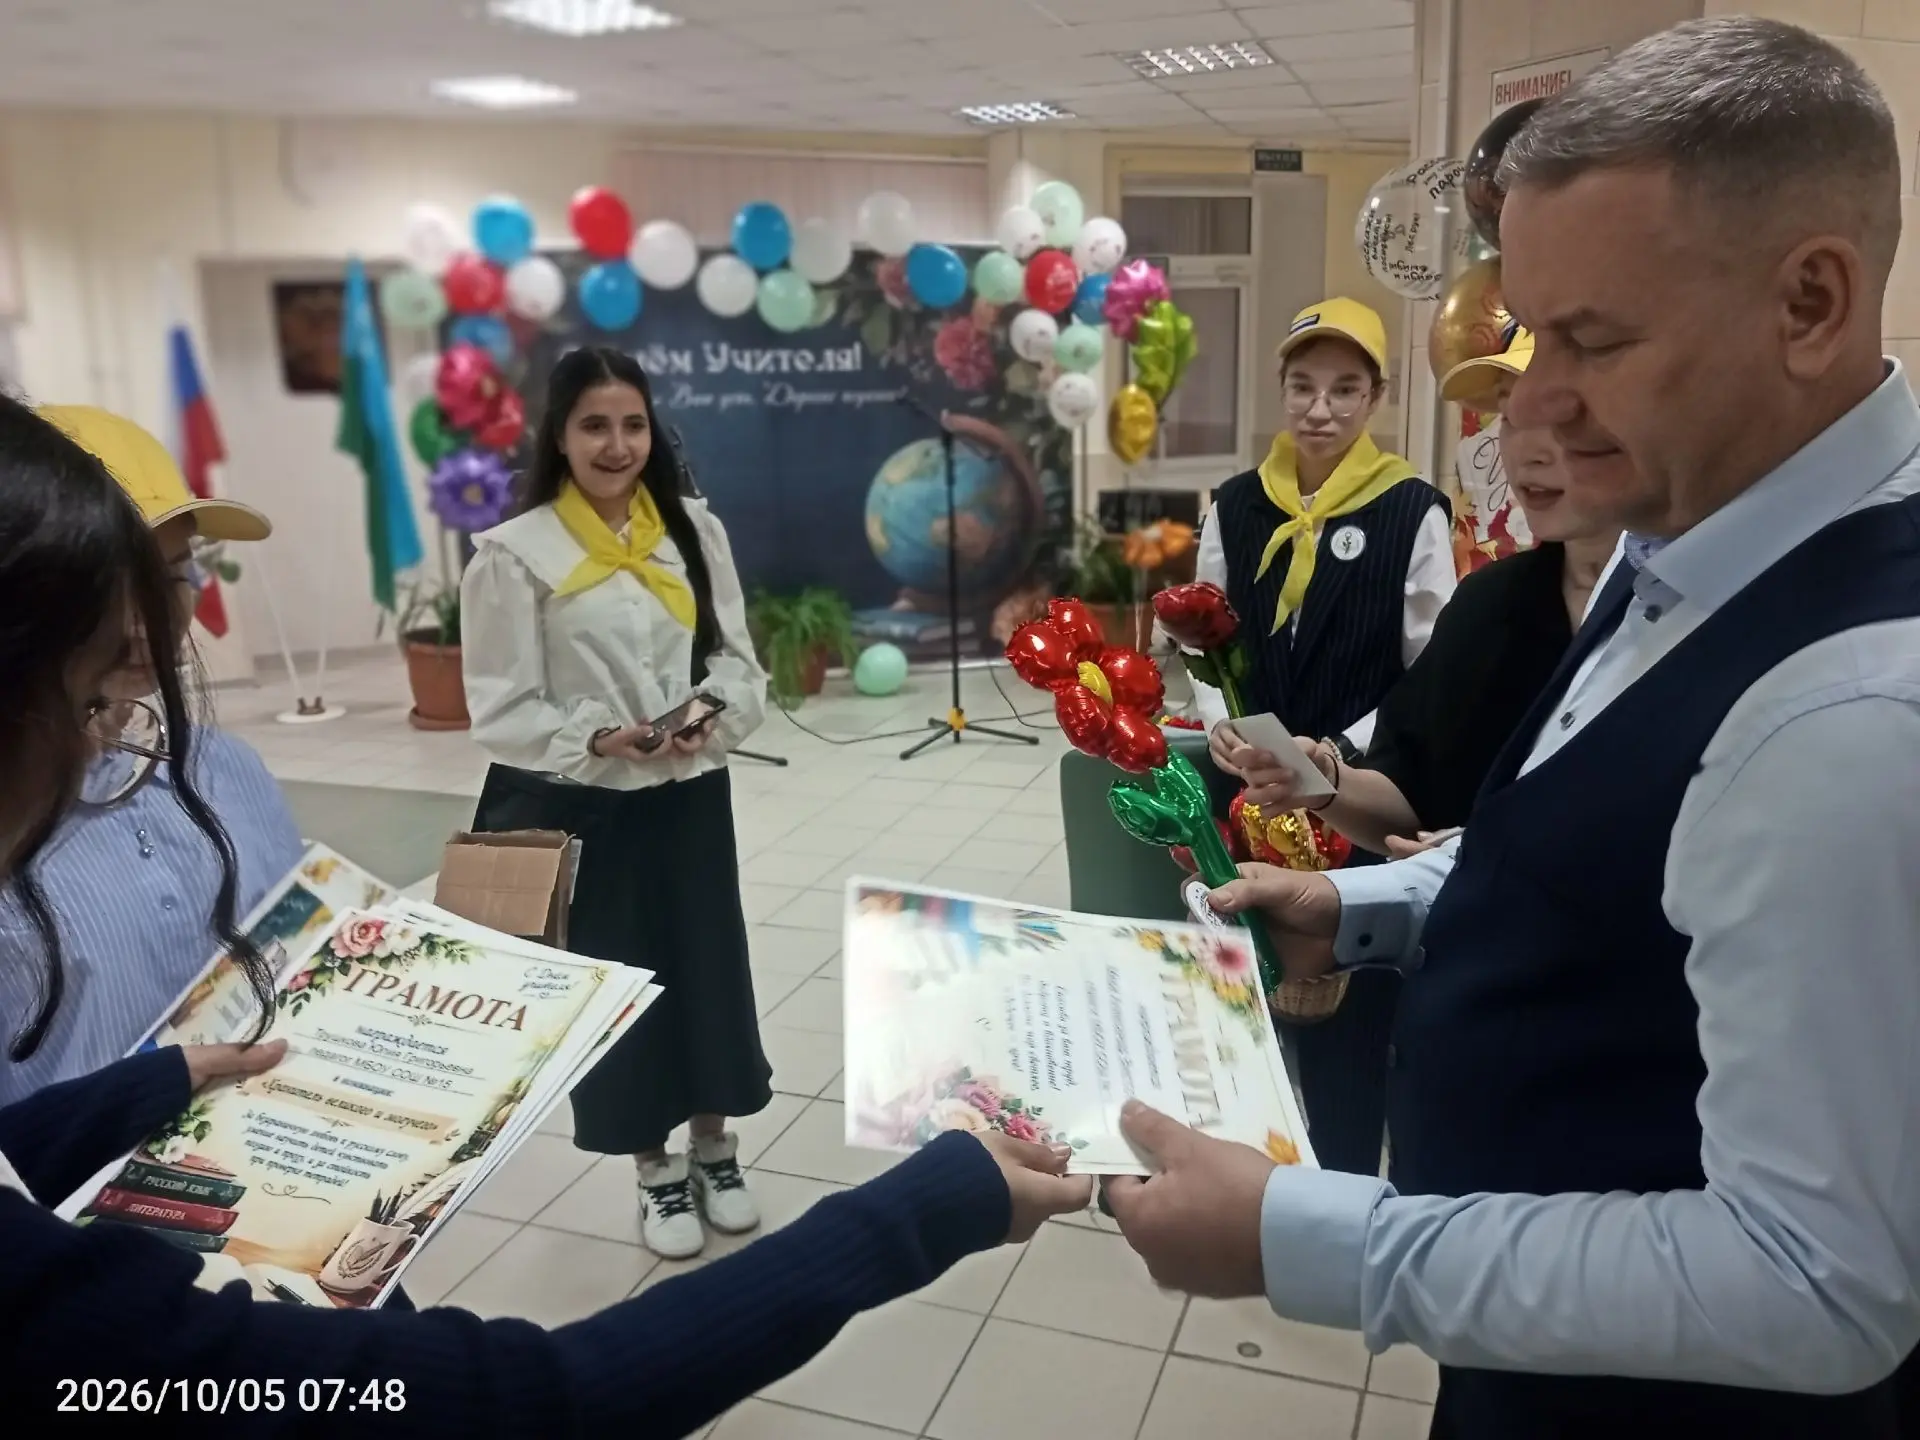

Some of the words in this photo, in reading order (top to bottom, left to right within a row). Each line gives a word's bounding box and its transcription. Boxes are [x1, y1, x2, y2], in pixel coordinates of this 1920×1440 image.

[1494, 69, 1572, 106] ВНИМАНИЕ!
[703, 340, 862, 375] Учителя!
[343, 968, 529, 1031] ГРАМОТА
